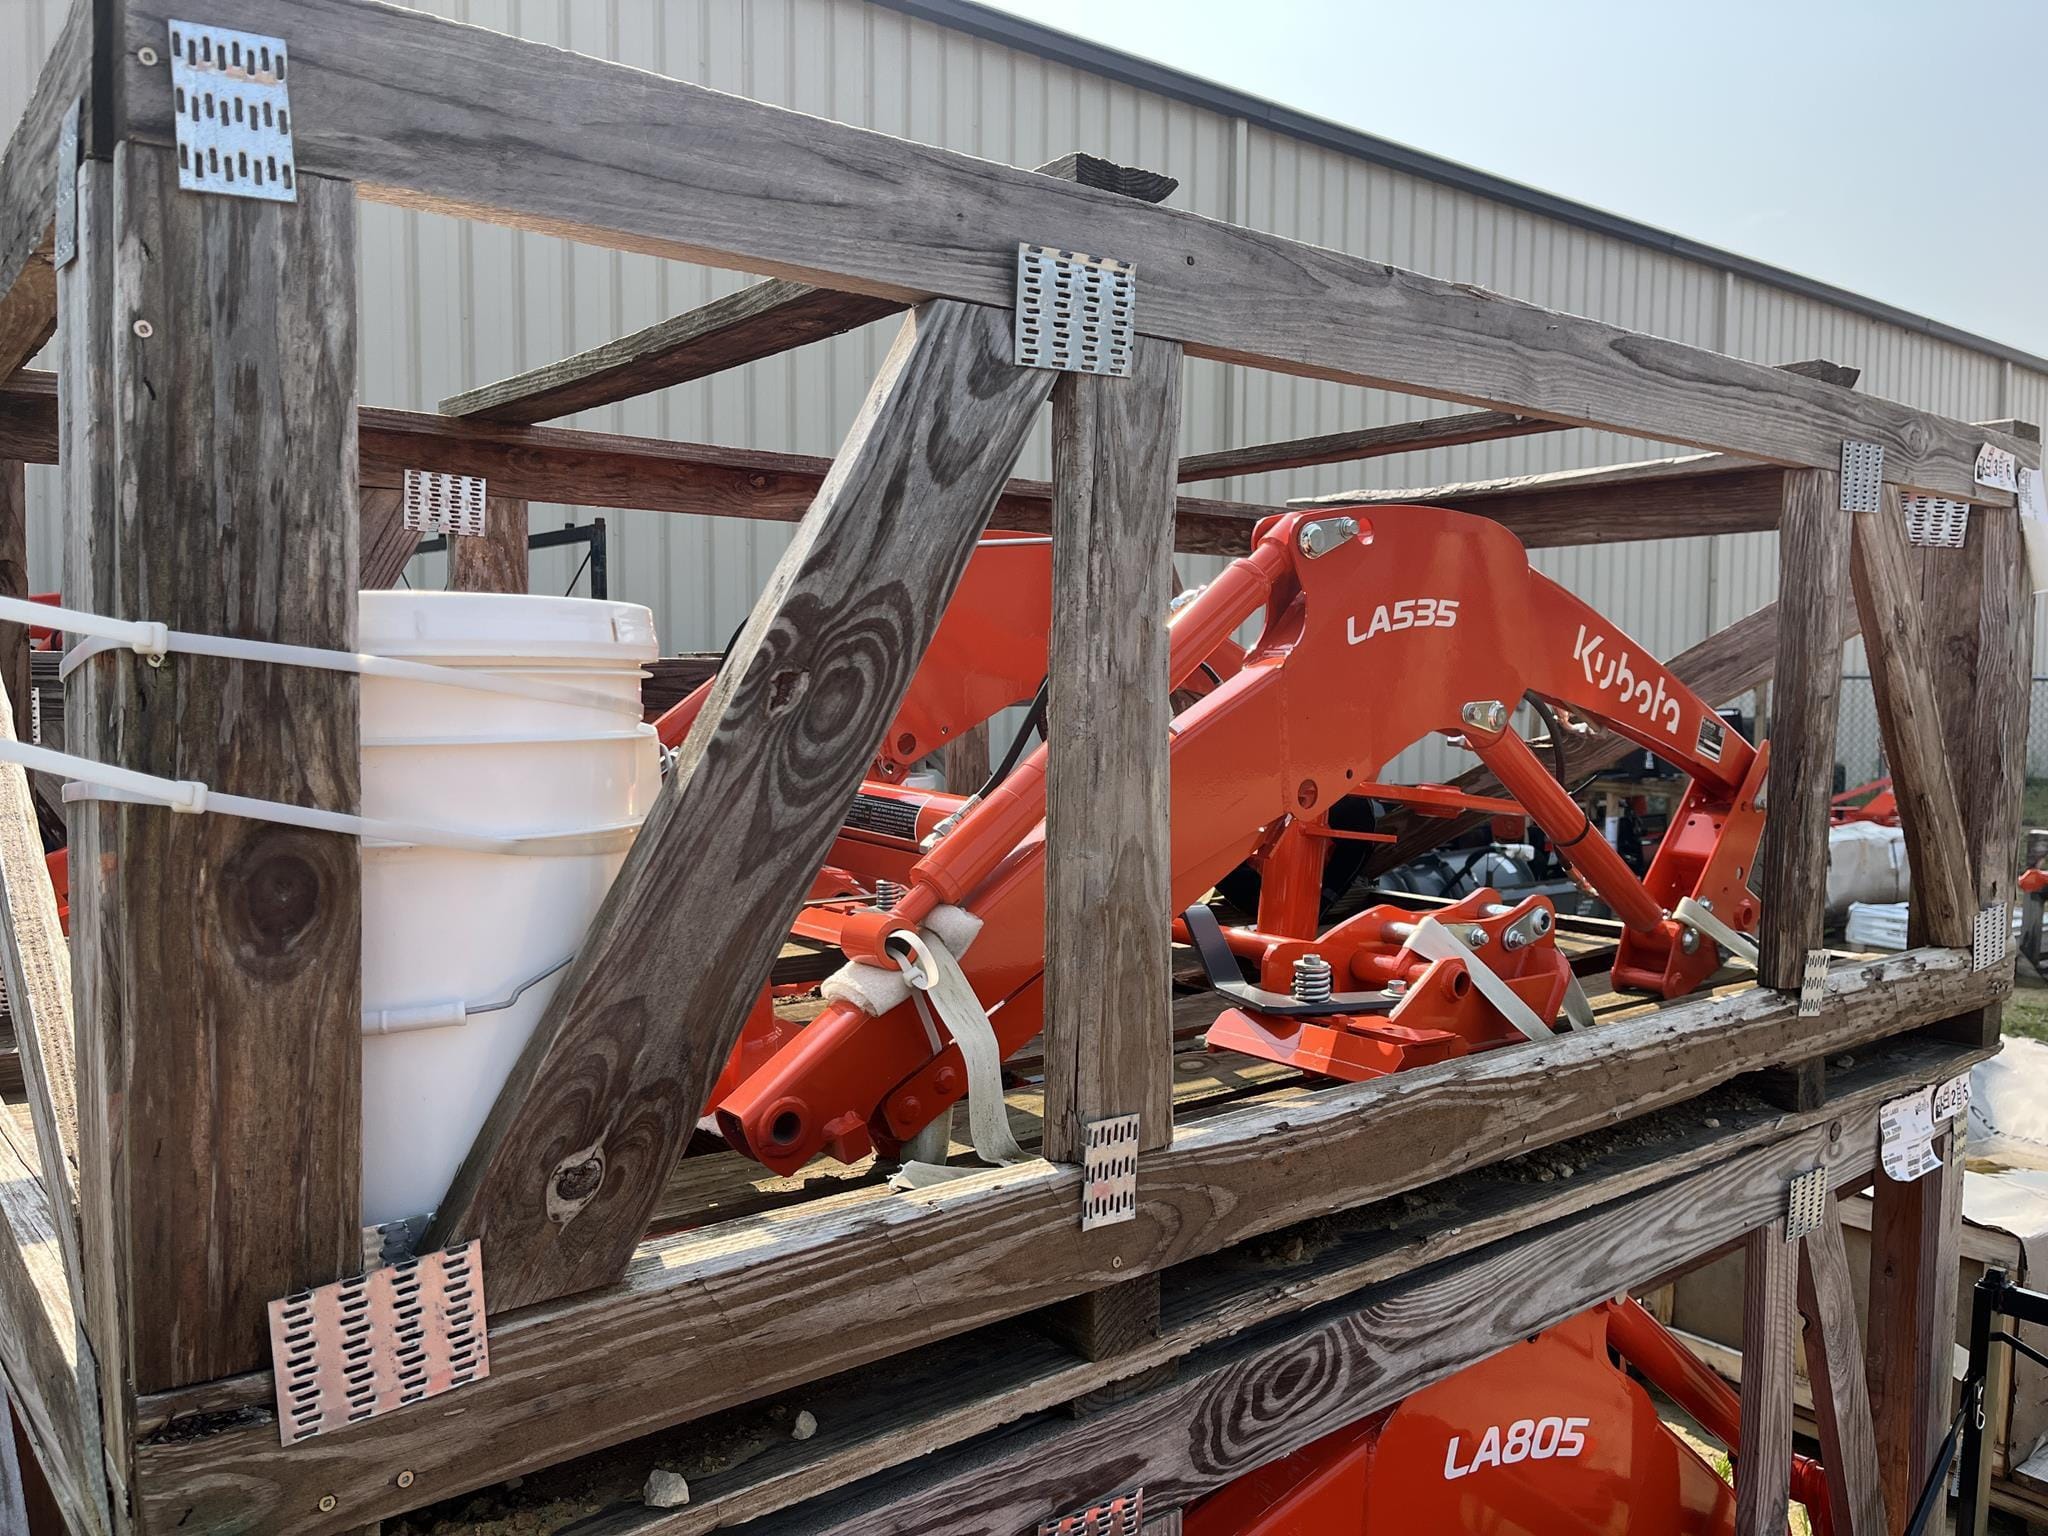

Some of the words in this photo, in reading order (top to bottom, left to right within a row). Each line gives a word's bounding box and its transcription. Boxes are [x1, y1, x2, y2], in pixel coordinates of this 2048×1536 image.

[1346, 598, 1460, 646] LA535
[1573, 624, 1681, 736] Kubota
[1443, 1416, 1591, 1481] LA805
